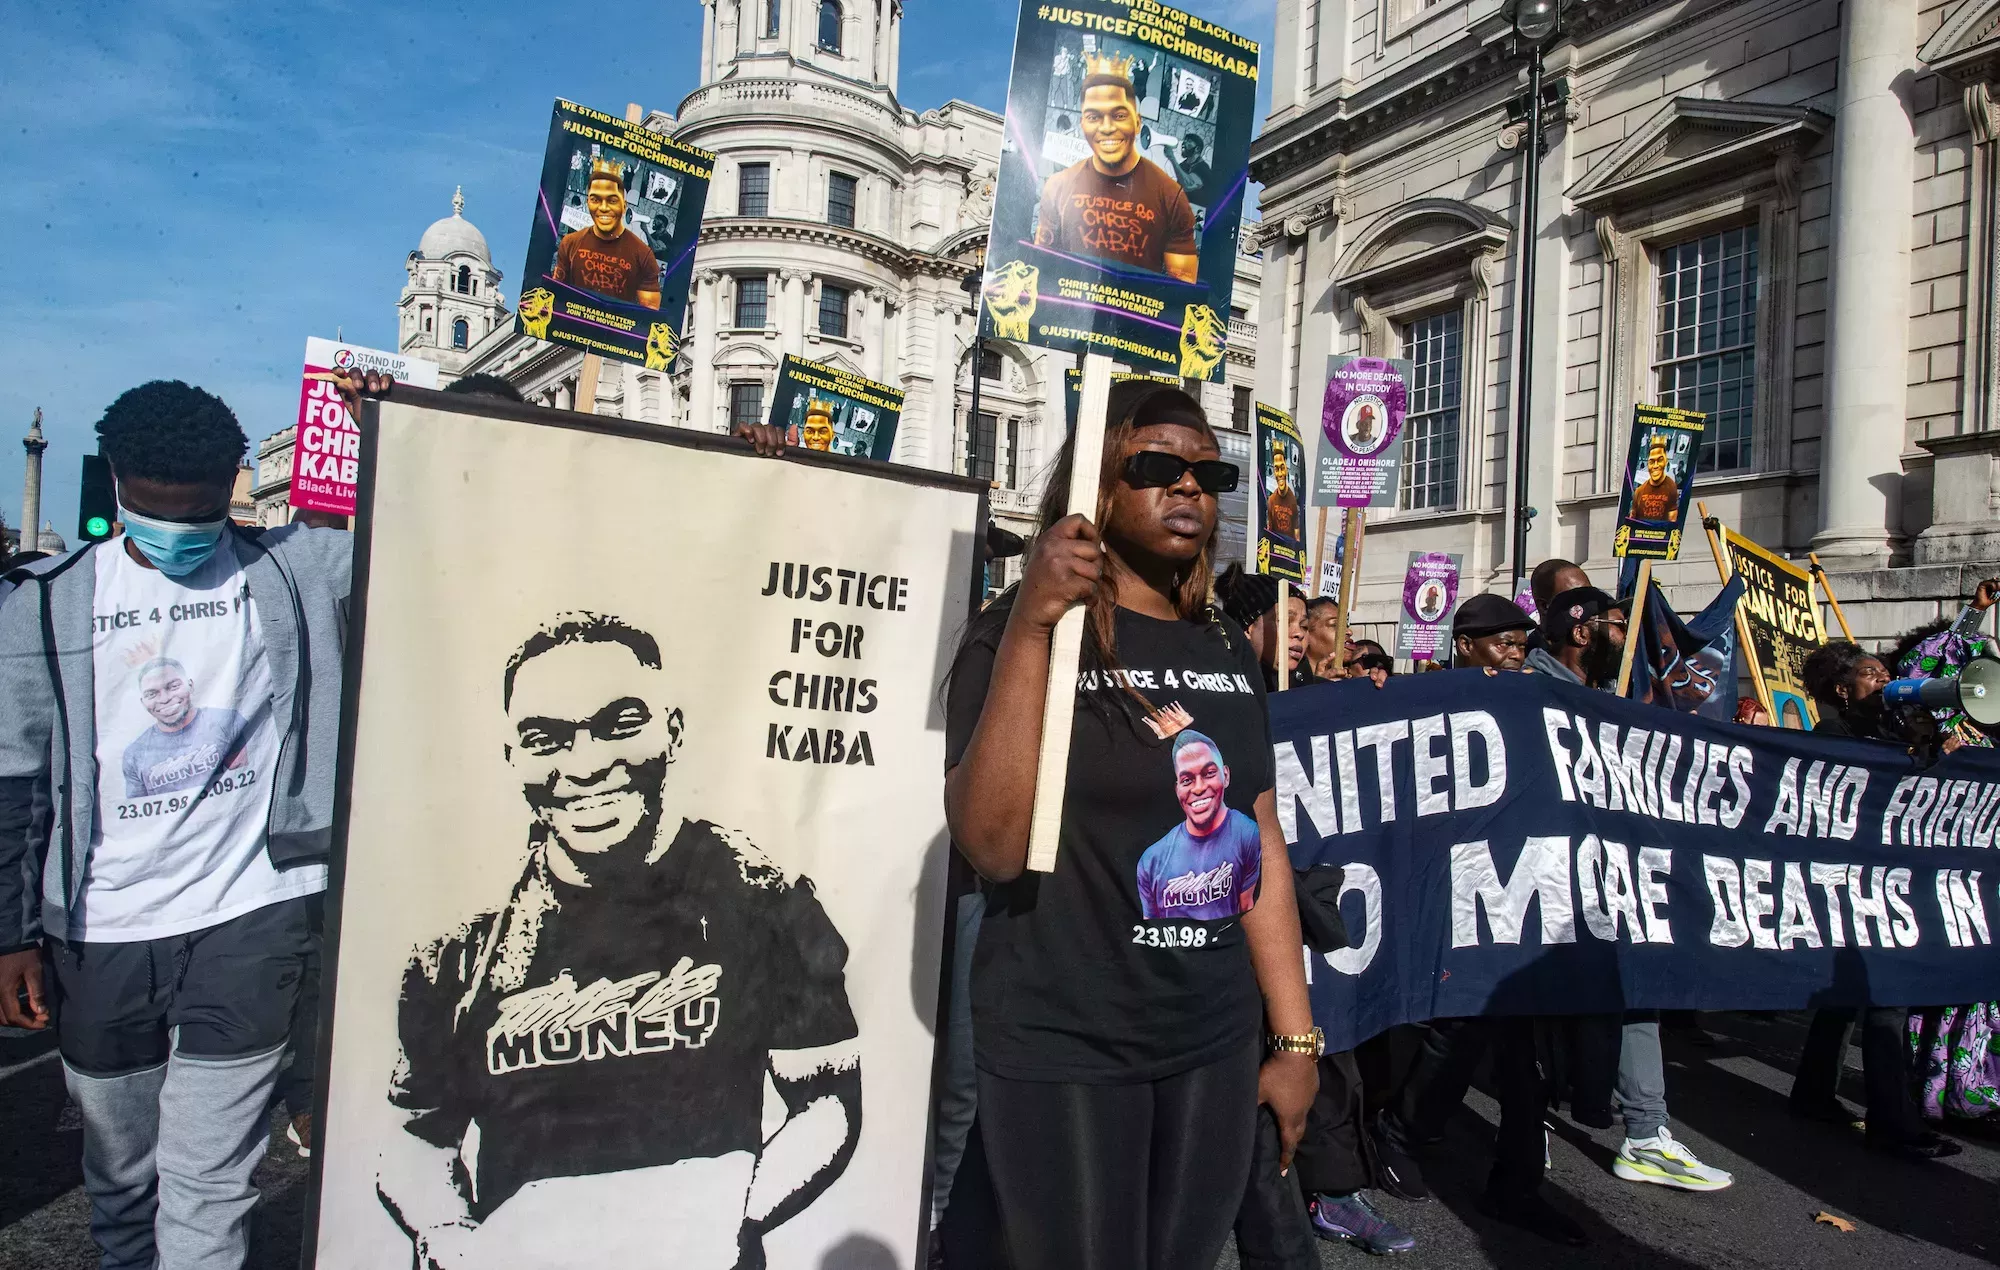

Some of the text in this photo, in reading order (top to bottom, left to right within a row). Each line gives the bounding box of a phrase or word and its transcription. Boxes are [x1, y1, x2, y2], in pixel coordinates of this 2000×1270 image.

[1129, 8, 1186, 37] SEEKING
[1161, 7, 1189, 25] FOR
[1189, 16, 1231, 43] BLACK
[1038, 5, 1258, 81] #JUSTICEFORCHRISKABA
[561, 101, 577, 113] WE
[578, 104, 611, 123] STAND
[612, 117, 645, 134] UNITED
[645, 130, 663, 142] FOR
[664, 135, 694, 154] BLACK
[623, 130, 661, 151] SEEKING
[562, 120, 713, 180] #JUSTICEFORCHRISKABA
[1072, 193, 1134, 211] JUSTICE
[1082, 208, 1142, 235] CHRIS
[1077, 225, 1149, 257] KABA!
[585, 259, 623, 278] CHRIS
[1058, 277, 1165, 310] CHRIS KABA MATTERS
[1059, 287, 1160, 318] JOIN THE MOVEMENT
[566, 302, 636, 327] CHRIS KABA MATTERS
[566, 308, 633, 332] JOIN THE MOVEMENT
[552, 330, 644, 360] @JUSTICEFORCHRISKABA
[1039, 325, 1177, 364] @JUSTICEFORCHRISKABA
[357, 353, 406, 370] STAND UP
[357, 363, 369, 373] TO
[789, 354, 801, 364] WE
[801, 358, 826, 372] STAND
[826, 365, 852, 380] UNITED
[852, 374, 867, 385] FOR
[867, 378, 890, 393] BLACK
[1068, 369, 1080, 377] WE
[1110, 371, 1131, 381] NITED
[834, 376, 865, 391] SEEKING
[1335, 370, 1403, 383] NO MORE DEATHS
[1345, 383, 1391, 393] IN CUSTODY
[788, 370, 903, 413] #JUSTICEFORCHRISKABA
[1322, 457, 1396, 467] OLADEJI OMISHORE
[298, 479, 333, 496] Black
[1323, 563, 1335, 577] WE
[761, 562, 909, 612] JUSTICE
[1785, 582, 1808, 609] FOR
[149, 607, 162, 624] 4
[169, 600, 228, 622] CHRIS
[790, 618, 865, 660] FOR
[768, 670, 879, 714] CHRIS
[1164, 669, 1180, 689] 4
[1182, 669, 1236, 693] CHRIS
[766, 723, 875, 766] KABA
[149, 752, 220, 789] MONEY
[1543, 706, 1753, 830] FAMILIES
[1764, 756, 1870, 841] AND
[1881, 775, 2000, 850] FRIEND
[118, 796, 189, 820] 23.07.98
[1163, 876, 1233, 908] MONEY
[1450, 833, 1675, 950] MORE
[1703, 853, 1920, 951] DEATHS
[1935, 868, 1992, 948] IN
[487, 997, 721, 1075] MONEY
